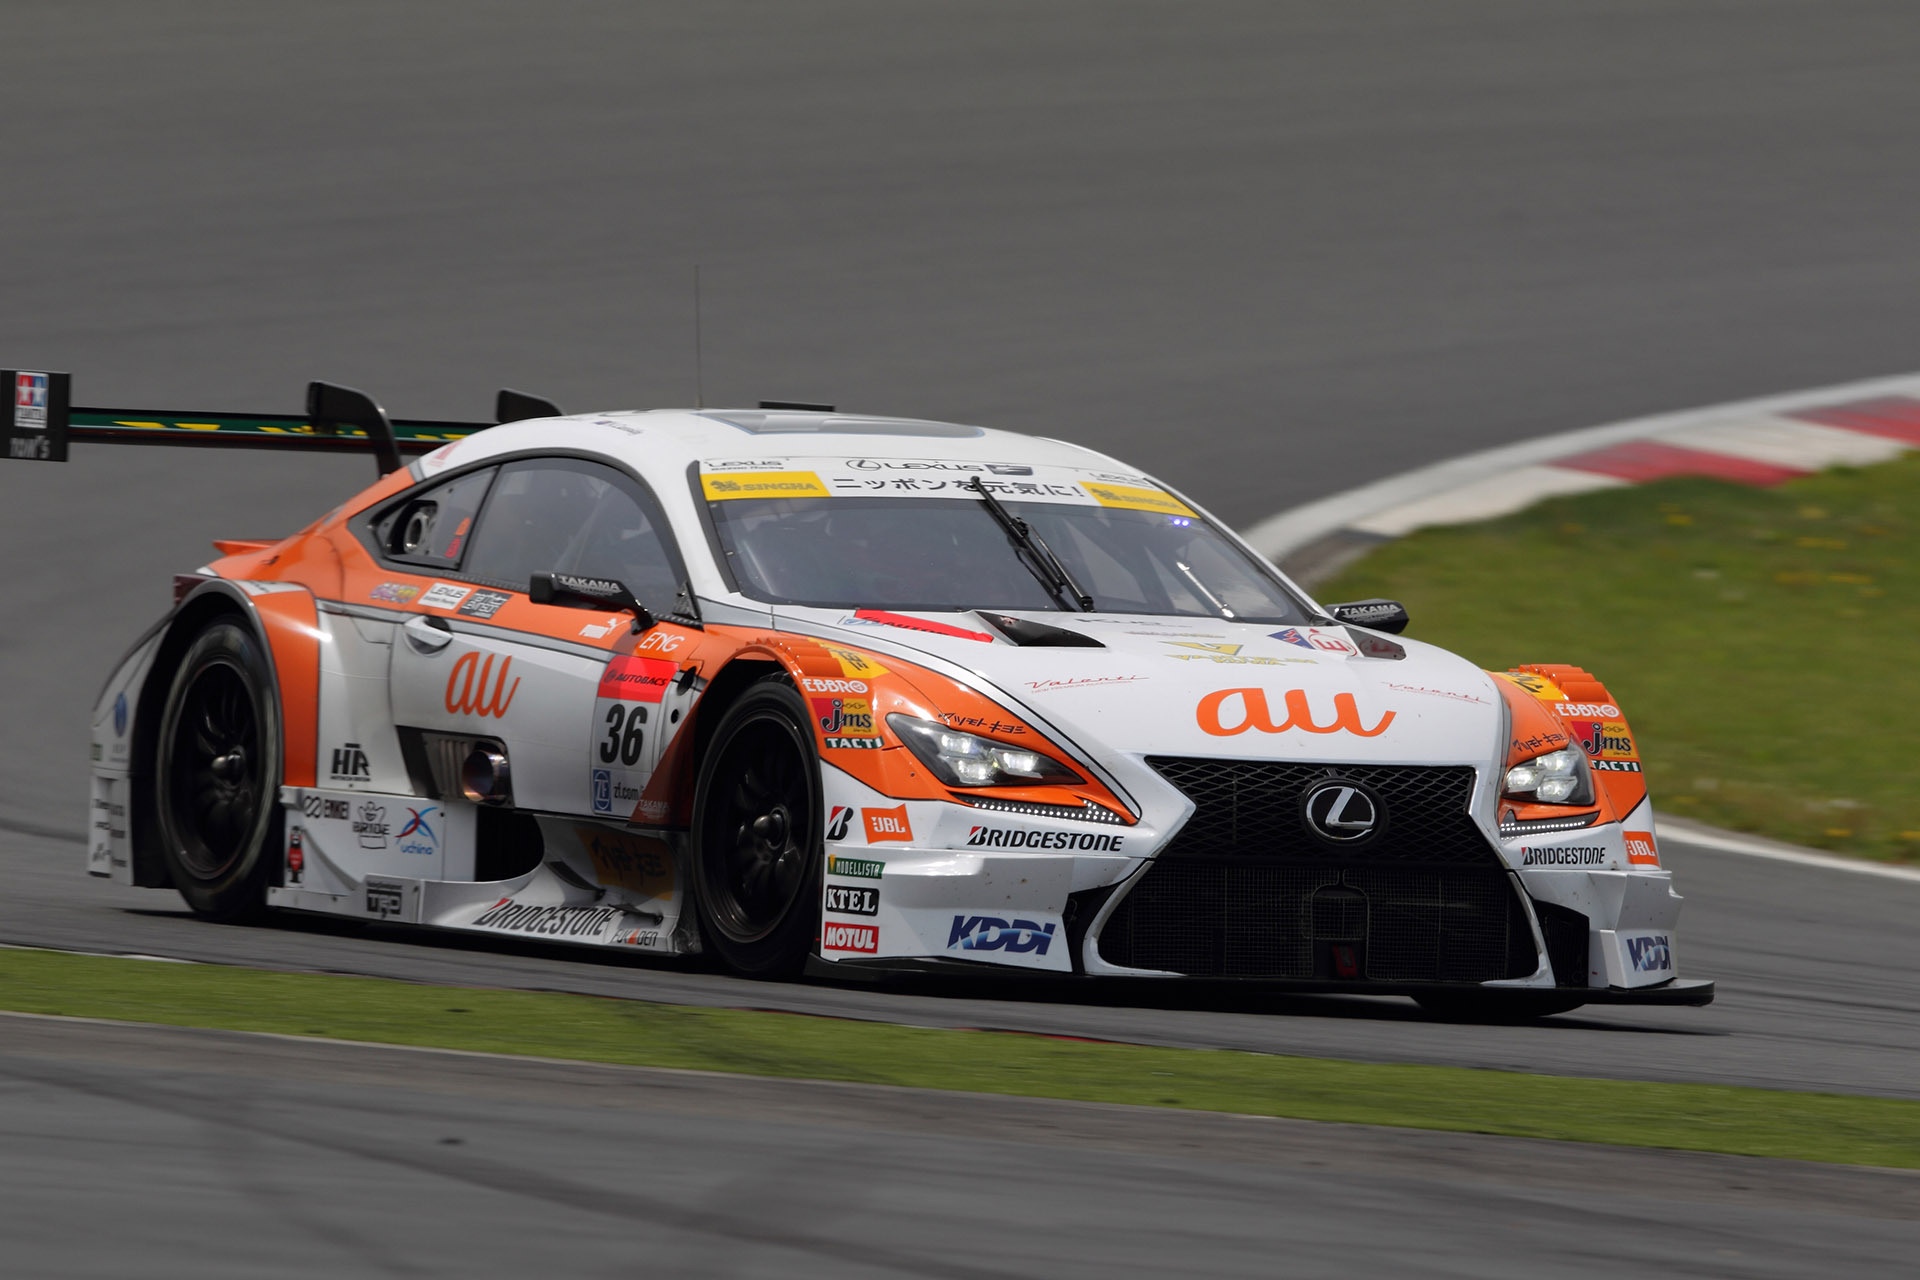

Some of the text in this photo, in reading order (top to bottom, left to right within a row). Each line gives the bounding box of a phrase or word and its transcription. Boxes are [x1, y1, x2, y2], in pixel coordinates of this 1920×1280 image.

[884, 462, 984, 472] LEXUS
[743, 482, 818, 491] SINGHA
[558, 575, 621, 591] TAKAMA
[1341, 603, 1401, 615] TAKAMA
[639, 631, 686, 653] ENG
[445, 651, 521, 719] au
[615, 672, 668, 687] AUTOBACS
[802, 678, 868, 693] EBBRO
[821, 698, 872, 733] jms
[1196, 687, 1397, 738] au
[1555, 703, 1620, 718] EBBRO
[600, 704, 648, 766] 36
[826, 736, 882, 749] TACTI
[1582, 722, 1631, 755] jms
[352, 821, 390, 835] BRIDE
[873, 816, 906, 834] JBL
[966, 826, 1124, 852] BRIDGESTONE
[1625, 839, 1656, 857] JBL
[1521, 847, 1606, 866] BRIDGESTONE
[836, 860, 881, 877] MODELLISTA
[827, 888, 876, 912] KTEL
[472, 898, 617, 937] BRIDGESTONE
[825, 926, 876, 950] MOTUL
[947, 915, 1056, 956] KDDI
[1627, 936, 1671, 972] KDDI
